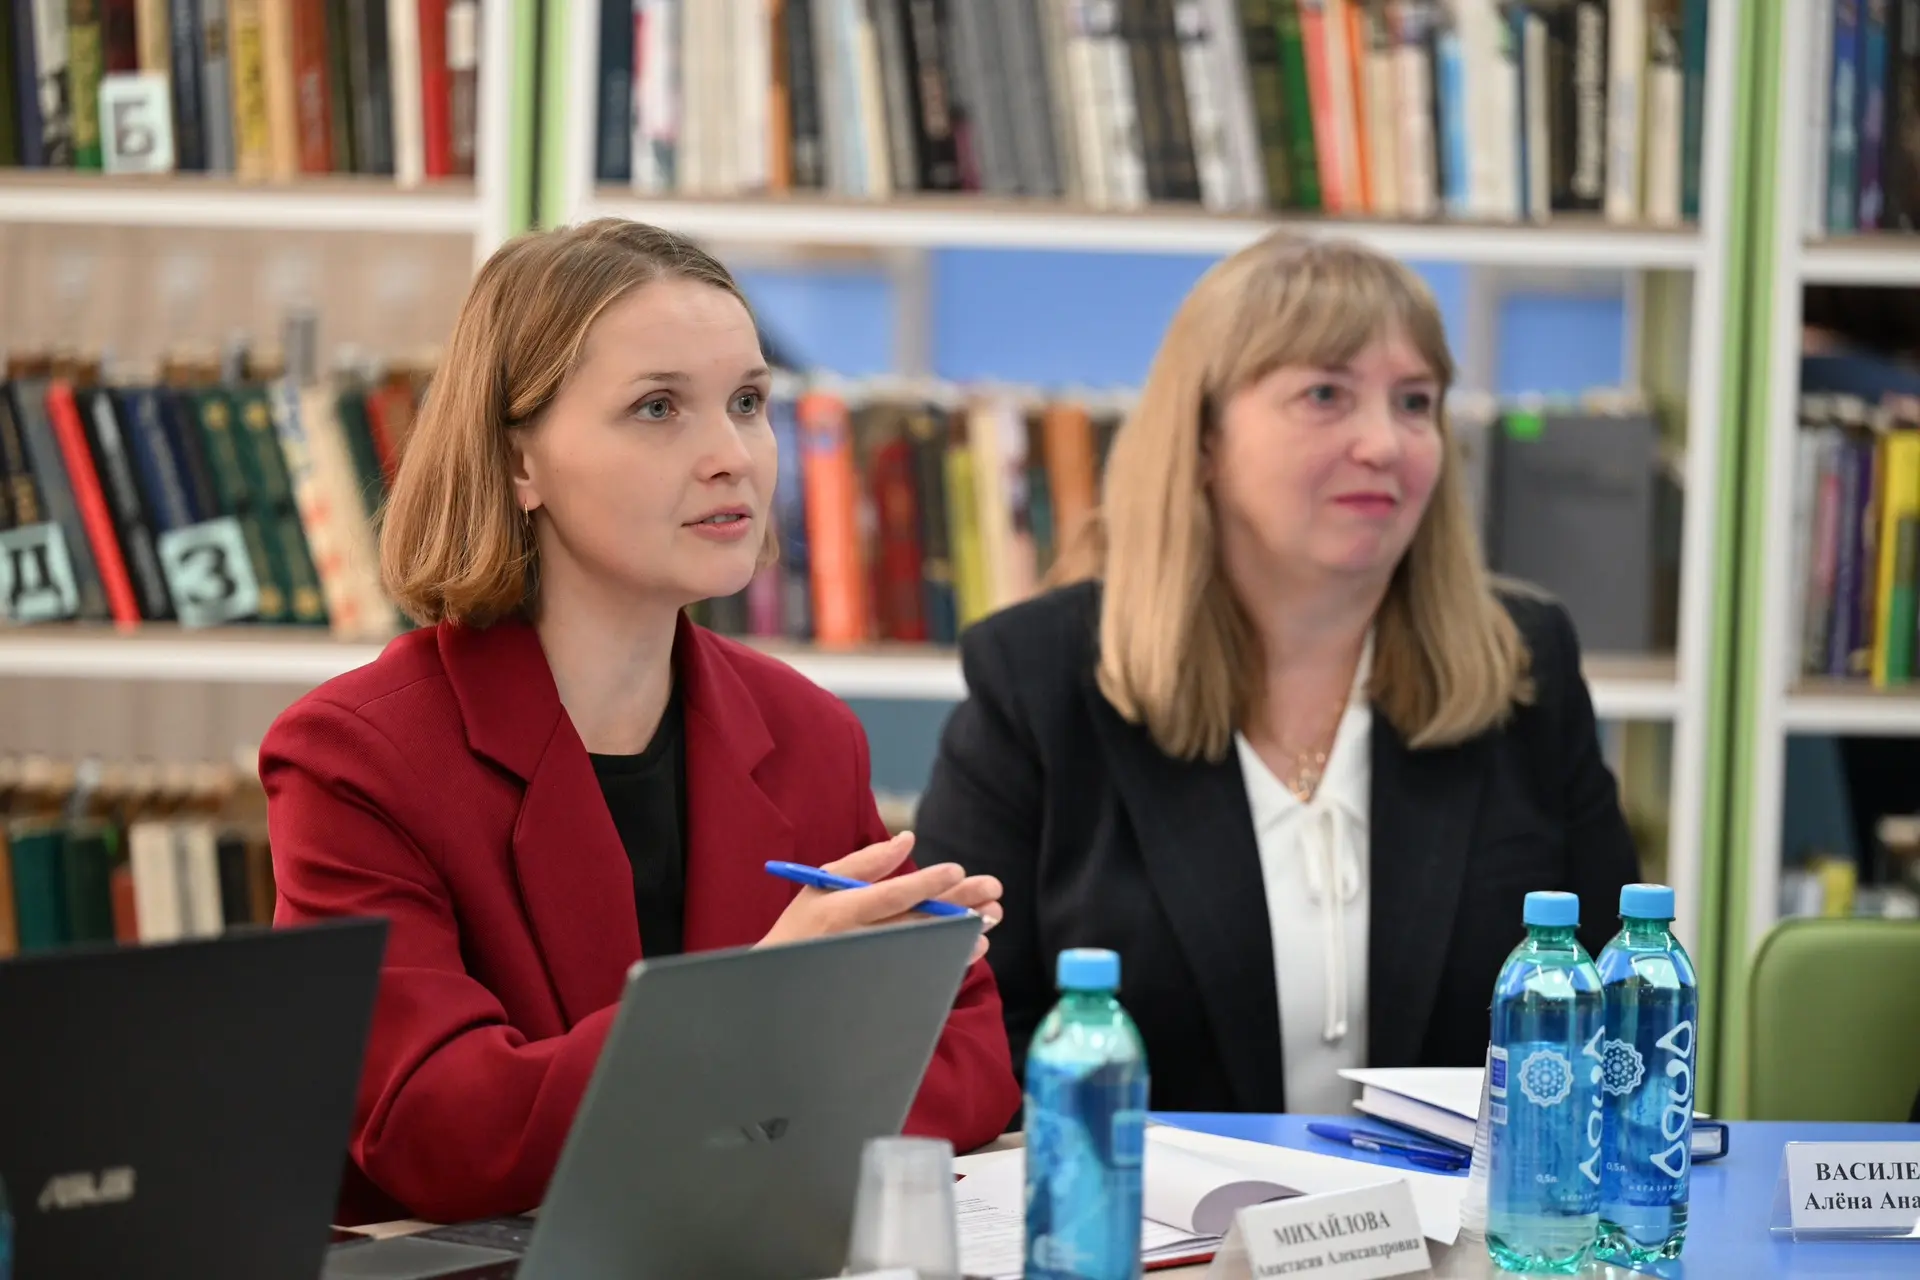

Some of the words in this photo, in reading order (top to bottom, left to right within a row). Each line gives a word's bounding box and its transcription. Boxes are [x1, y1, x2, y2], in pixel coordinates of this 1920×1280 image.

[113, 97, 157, 156] Б
[8, 543, 66, 616] Д
[1815, 1162, 1920, 1181] ВАСИЛЕ
[1805, 1192, 1873, 1210] Алёна
[1879, 1192, 1920, 1210] Ана
[1273, 1210, 1390, 1247] МИХАЙЛОВА
[1257, 1254, 1324, 1277] Анастасия
[1327, 1239, 1420, 1265] Александровна
